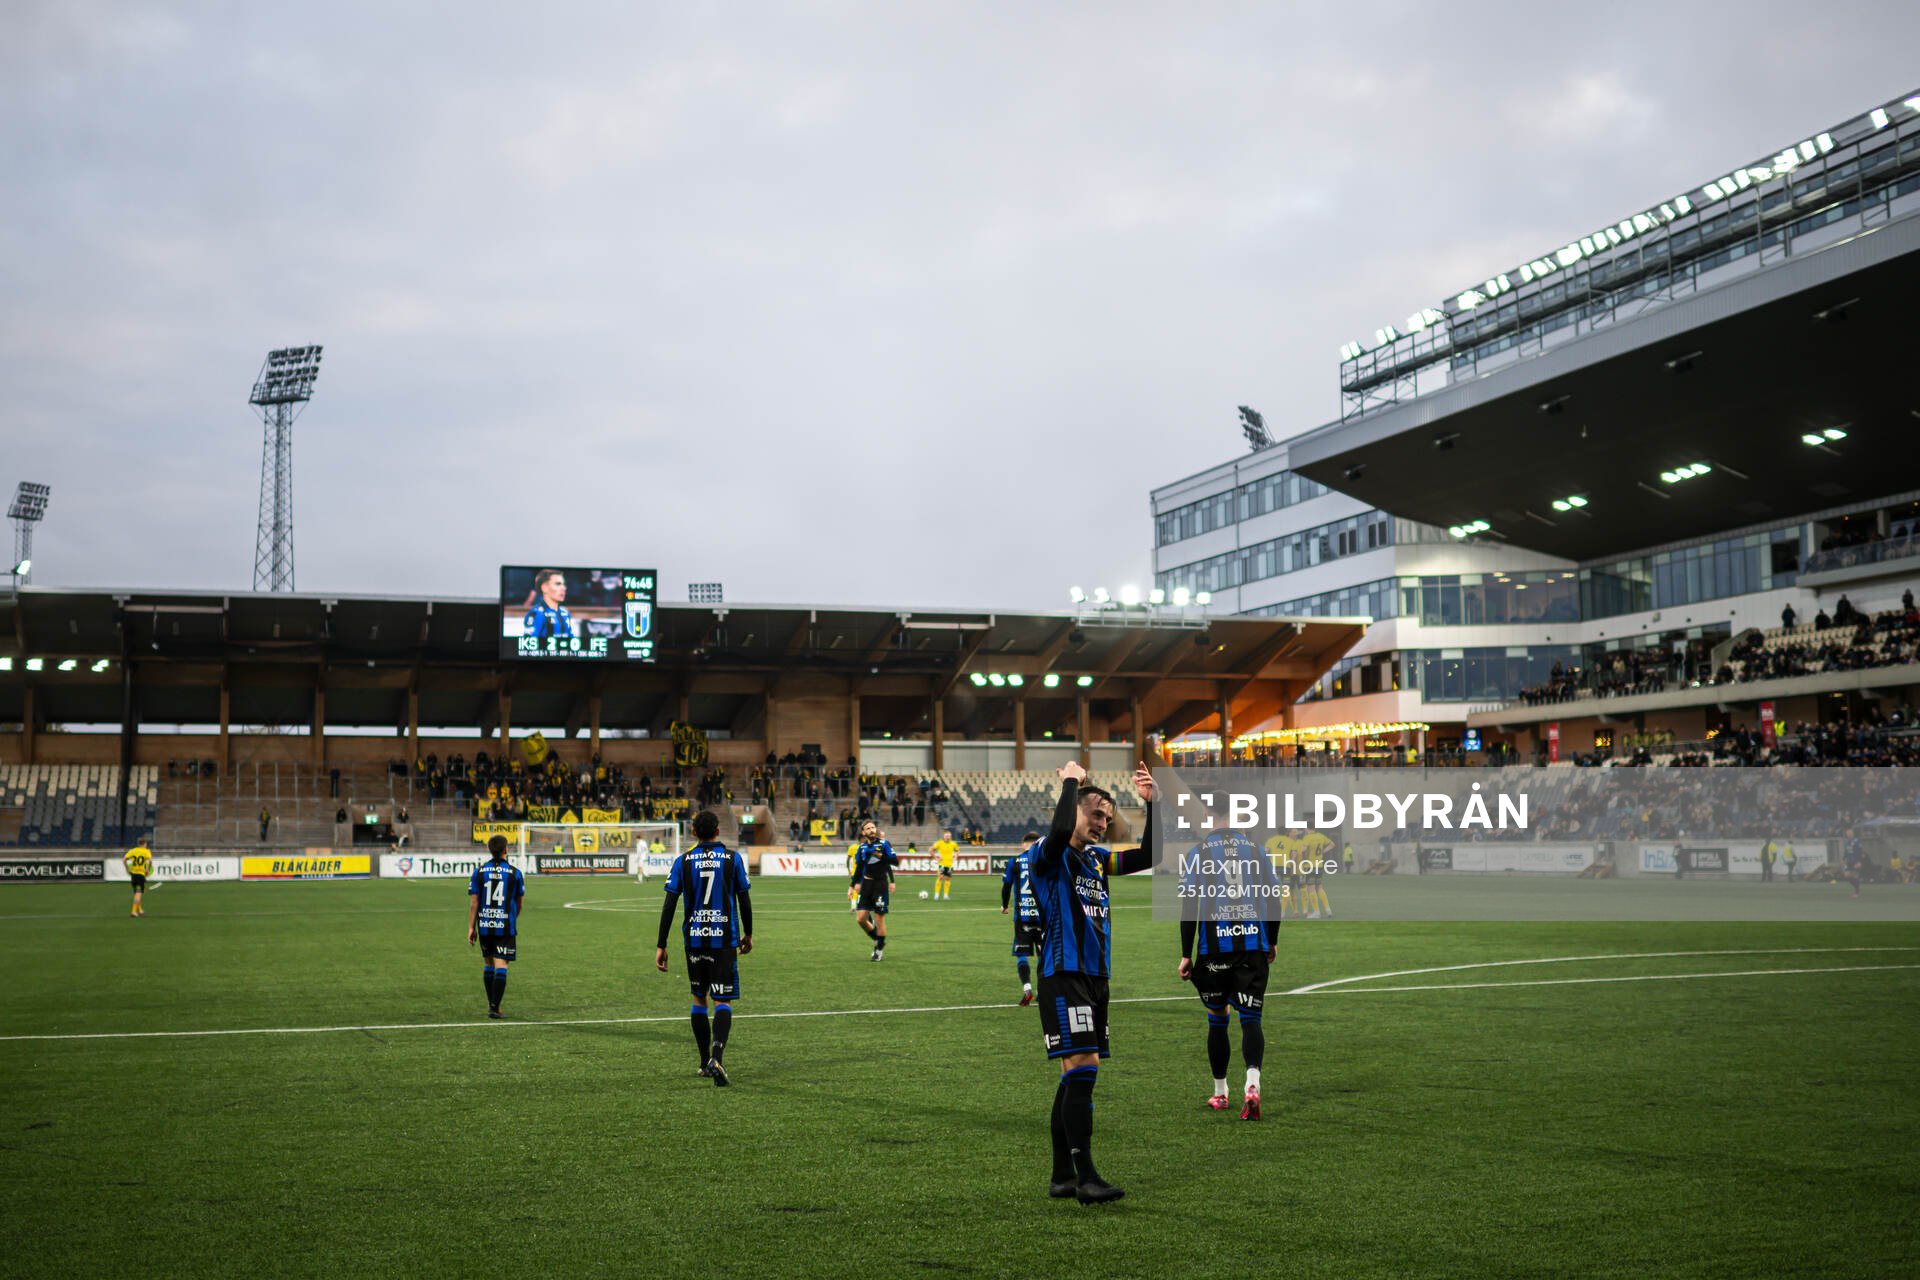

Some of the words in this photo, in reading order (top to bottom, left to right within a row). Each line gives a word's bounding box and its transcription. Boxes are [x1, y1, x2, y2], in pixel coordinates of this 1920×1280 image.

[518, 637, 538, 651] IKS
[547, 637, 557, 651] 2
[570, 638, 580, 651] 0
[590, 638, 607, 652] IFE
[131, 856, 145, 867] 20
[541, 858, 572, 868] SKIVOR
[574, 858, 591, 868] TILL
[593, 858, 625, 868] BYGGET
[695, 860, 721, 869] PERSSON
[1076, 876, 1096, 888] BYGG
[484, 880, 504, 906] 14
[700, 871, 715, 905] 7
[1219, 904, 1254, 913] NORDIC
[479, 920, 505, 929] inkClub
[690, 926, 724, 937] inkClub
[1216, 924, 1259, 938] inkClub
